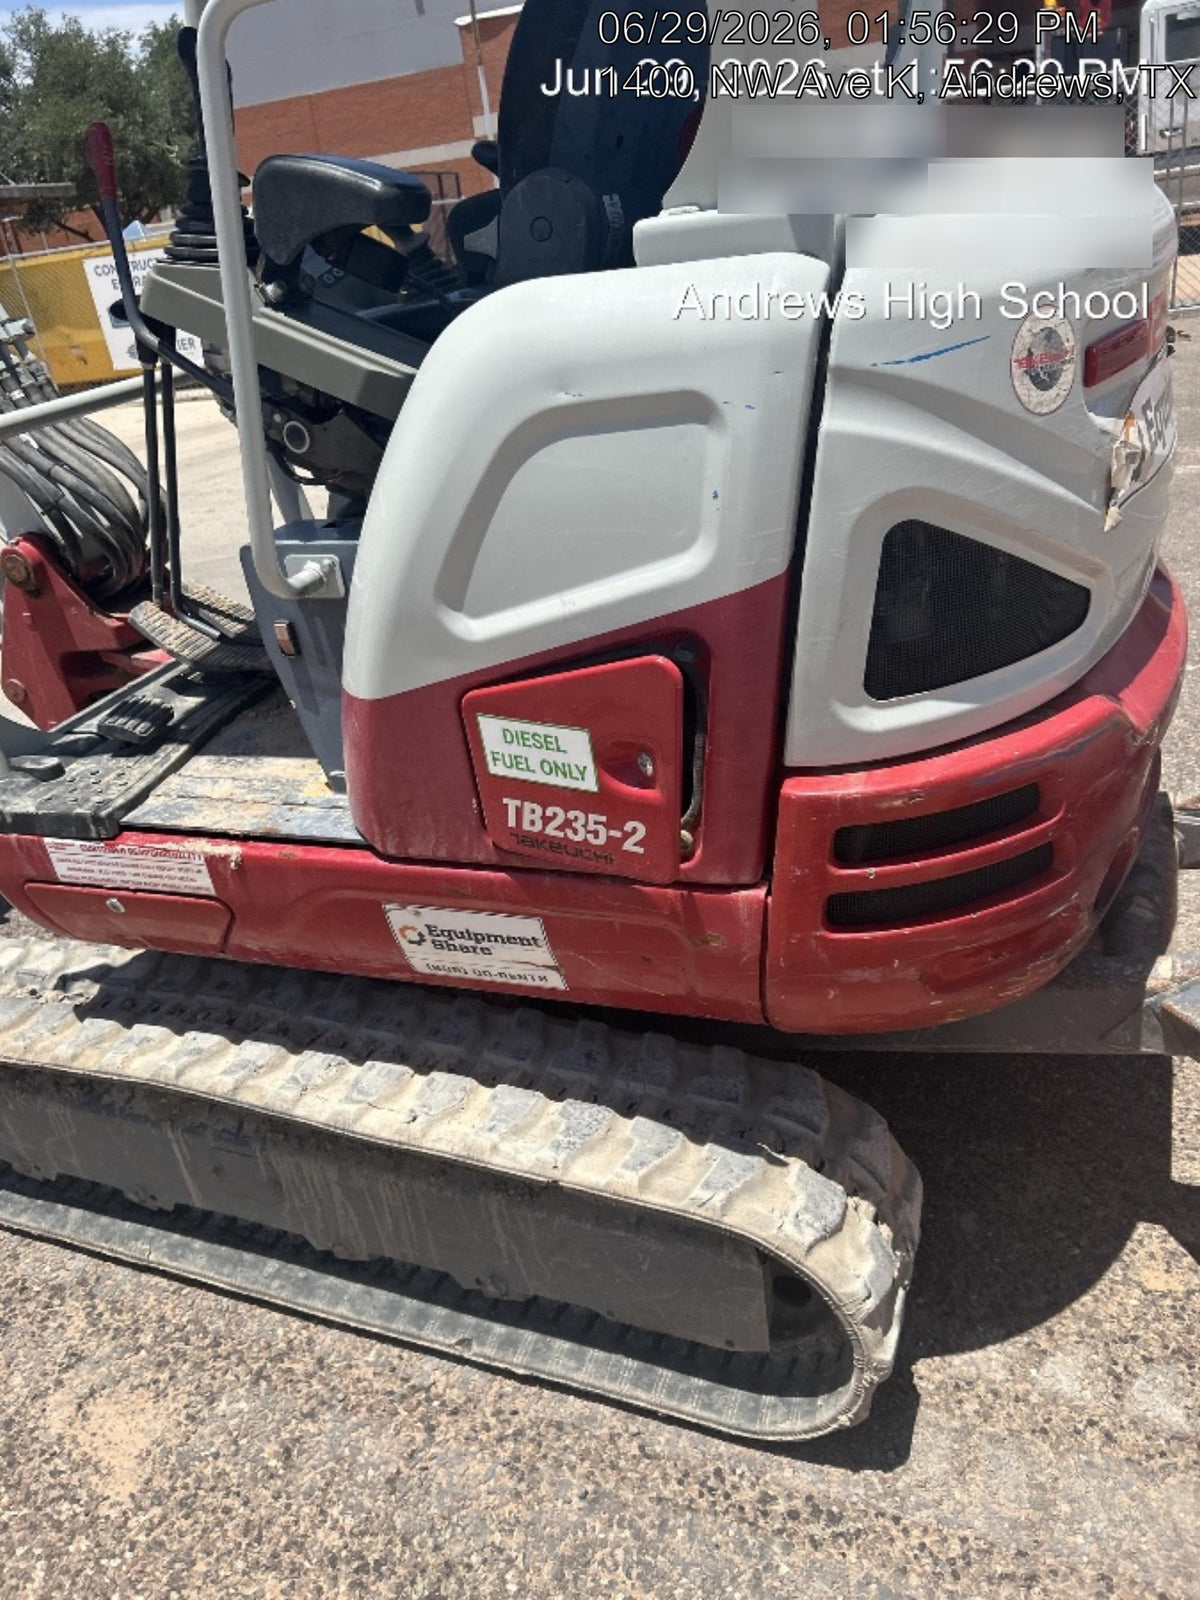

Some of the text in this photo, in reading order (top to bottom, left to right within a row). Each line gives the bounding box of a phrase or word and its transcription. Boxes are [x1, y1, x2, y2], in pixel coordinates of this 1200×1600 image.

[502, 728, 568, 755] DIESEL
[490, 750, 588, 782] FUEL ONLY
[502, 797, 647, 854] TB235-2
[424, 923, 543, 948] Equipment
[431, 939, 493, 956] Share
